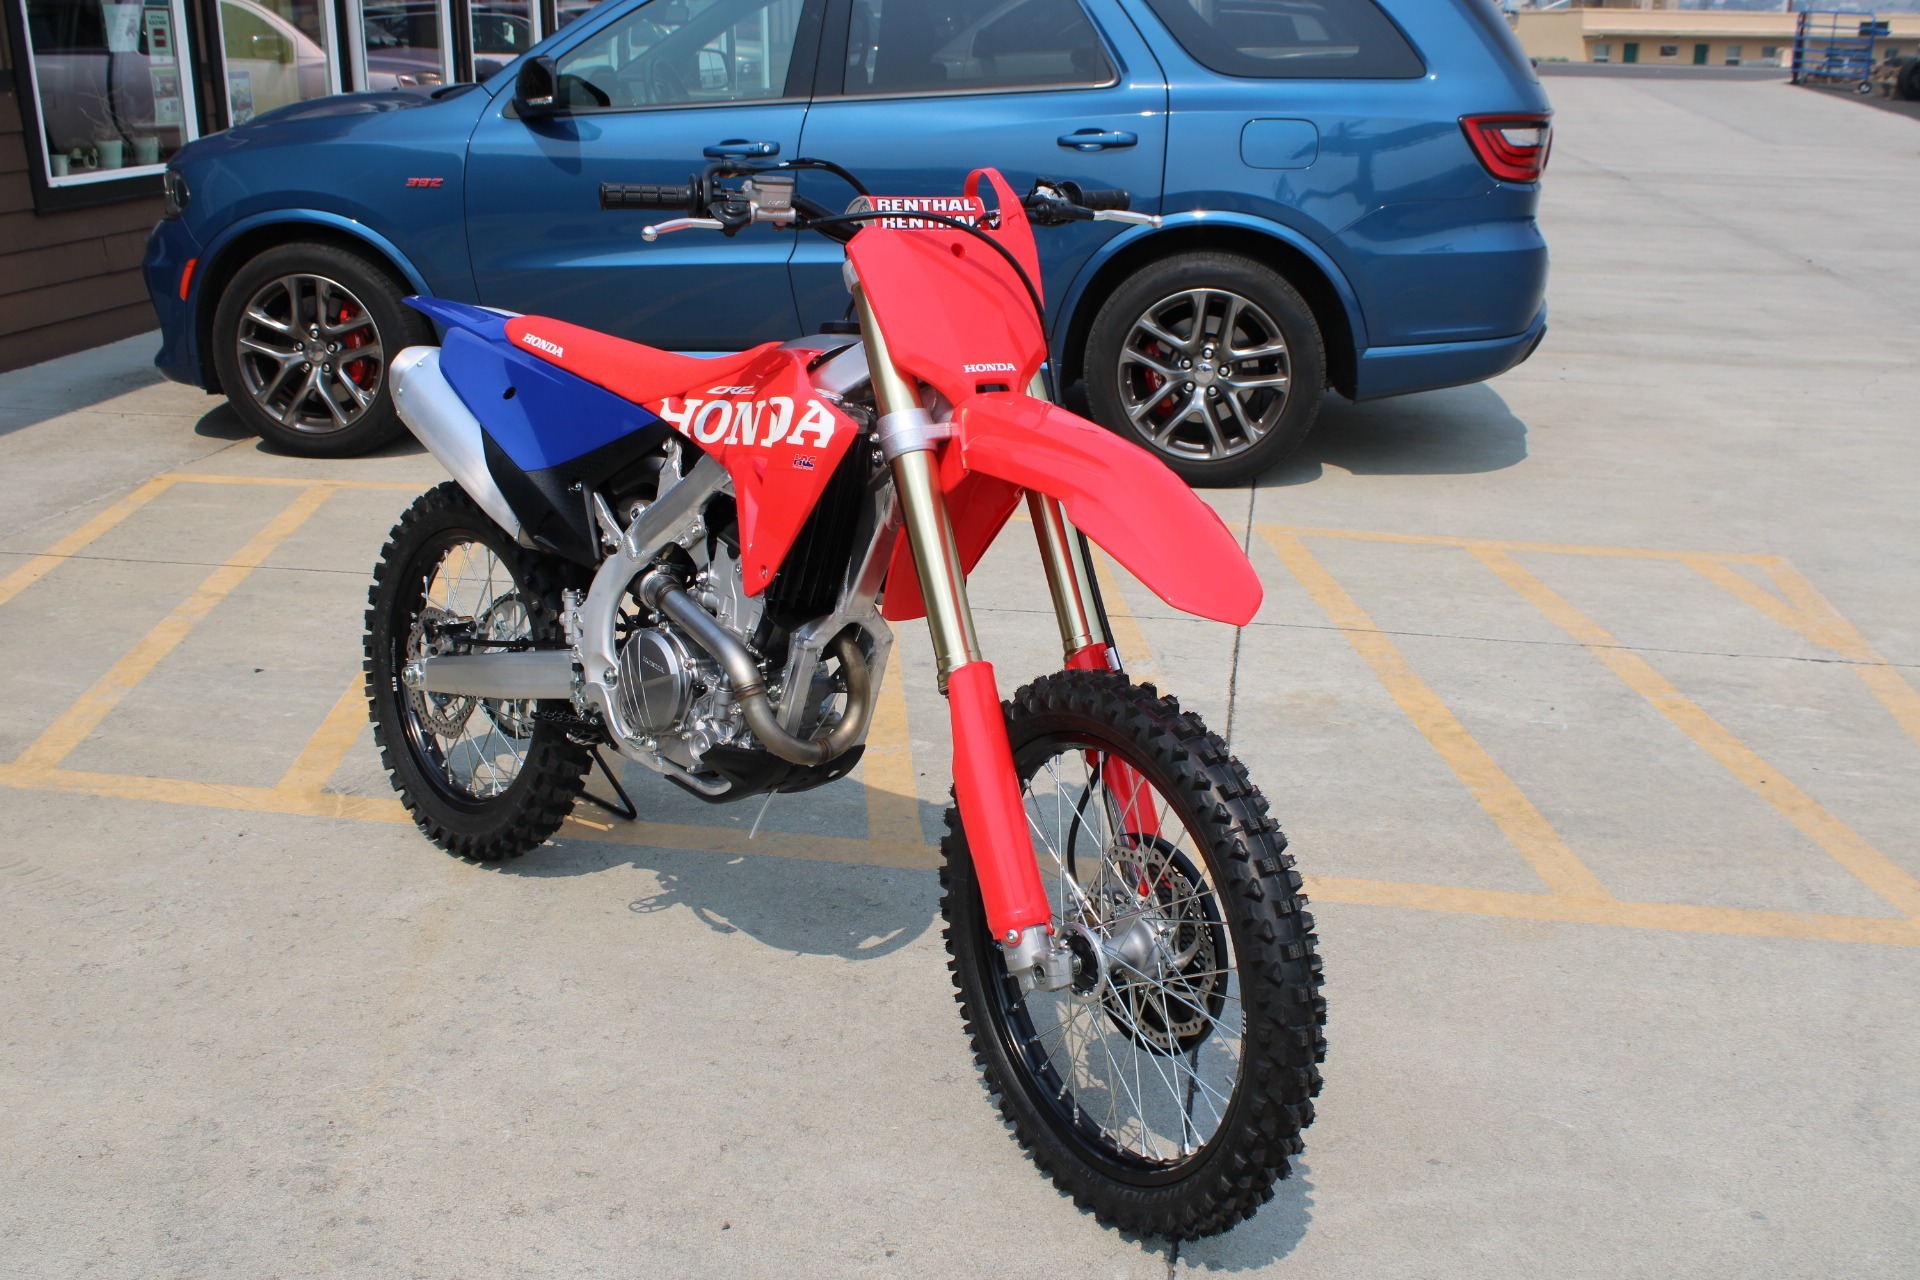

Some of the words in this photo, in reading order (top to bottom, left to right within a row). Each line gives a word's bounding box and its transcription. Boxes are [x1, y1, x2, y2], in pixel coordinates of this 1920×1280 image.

[405, 177, 444, 187] 392
[876, 198, 976, 212] RENTHAL
[881, 215, 982, 229] RENAL
[522, 332, 564, 358] HONDA
[963, 362, 1017, 373] HONDA
[659, 396, 836, 448] HONDA
